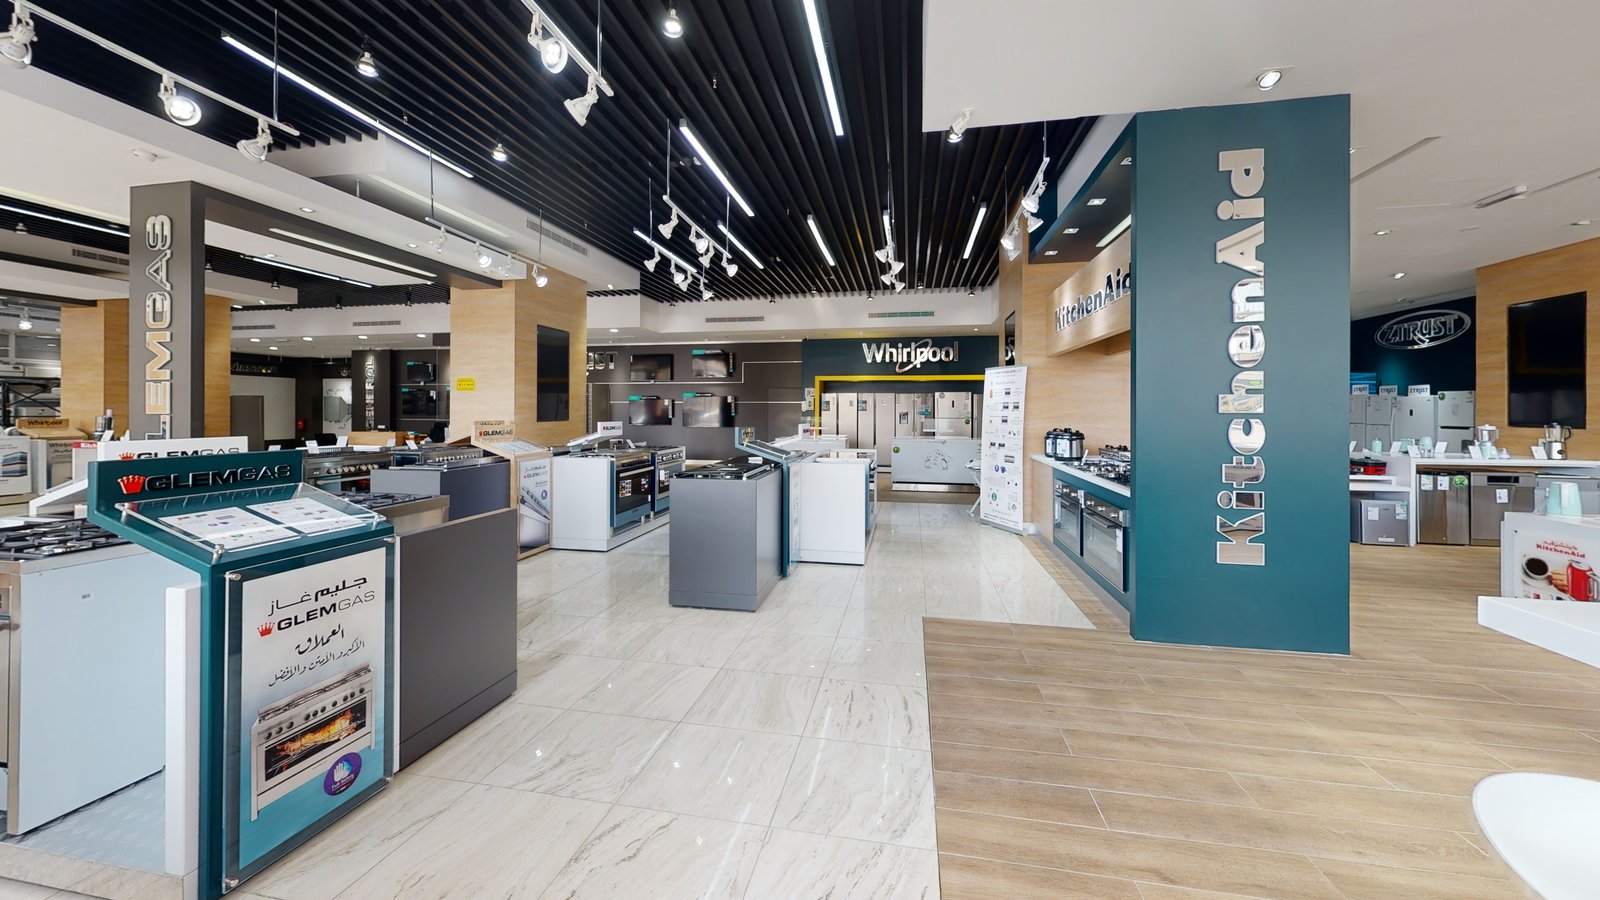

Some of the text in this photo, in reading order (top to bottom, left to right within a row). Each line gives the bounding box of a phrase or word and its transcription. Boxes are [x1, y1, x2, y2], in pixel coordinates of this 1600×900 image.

[145, 214, 172, 440] LEMGAS
[861, 339, 959, 370] Whirlpool
[1215, 148, 1266, 566] KitchenAid
[145, 464, 291, 492] GLEMGAS
[1535, 543, 1586, 559] KitchenAid
[267, 577, 368, 617] جليم غاز
[276, 590, 376, 632] GLEMGAS
[294, 622, 345, 655] العملاق
